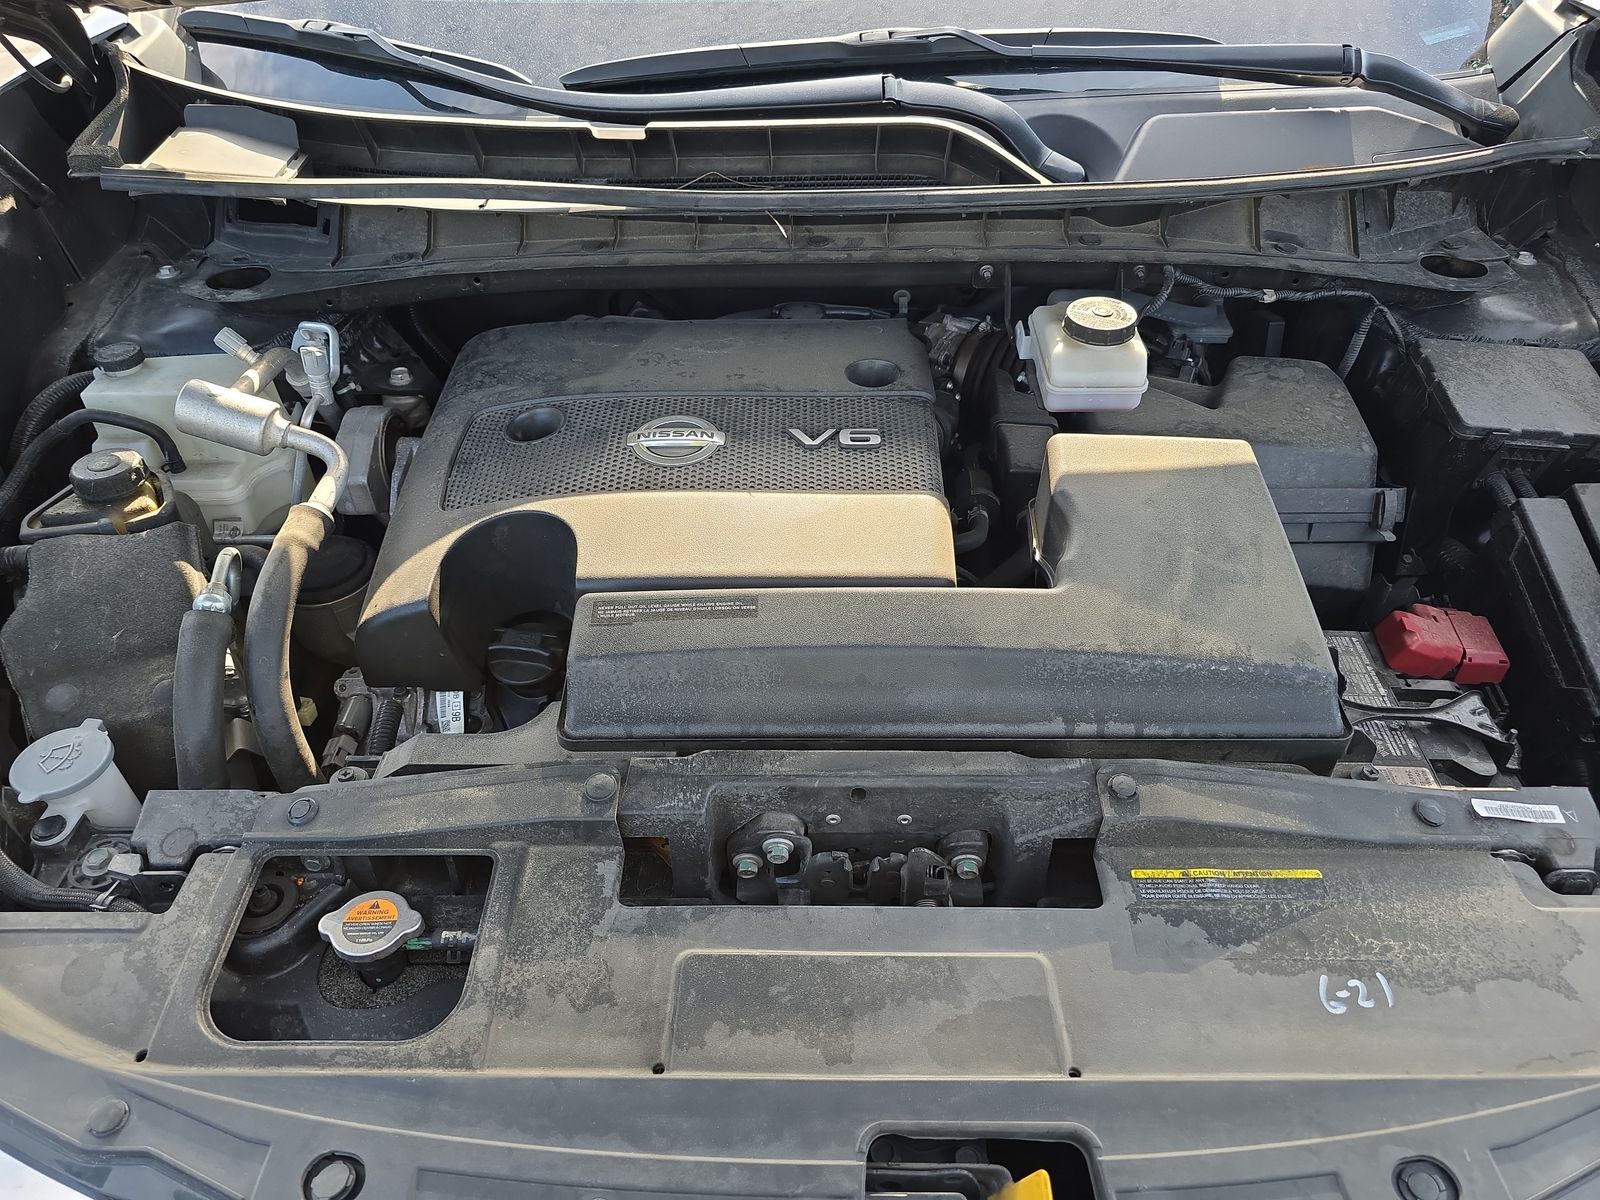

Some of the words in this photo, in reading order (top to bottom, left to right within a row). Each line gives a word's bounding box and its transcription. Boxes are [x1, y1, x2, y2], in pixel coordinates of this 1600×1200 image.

[636, 430, 716, 440] NISSAN
[787, 428, 882, 448] V6
[452, 711, 461, 722] 9B
